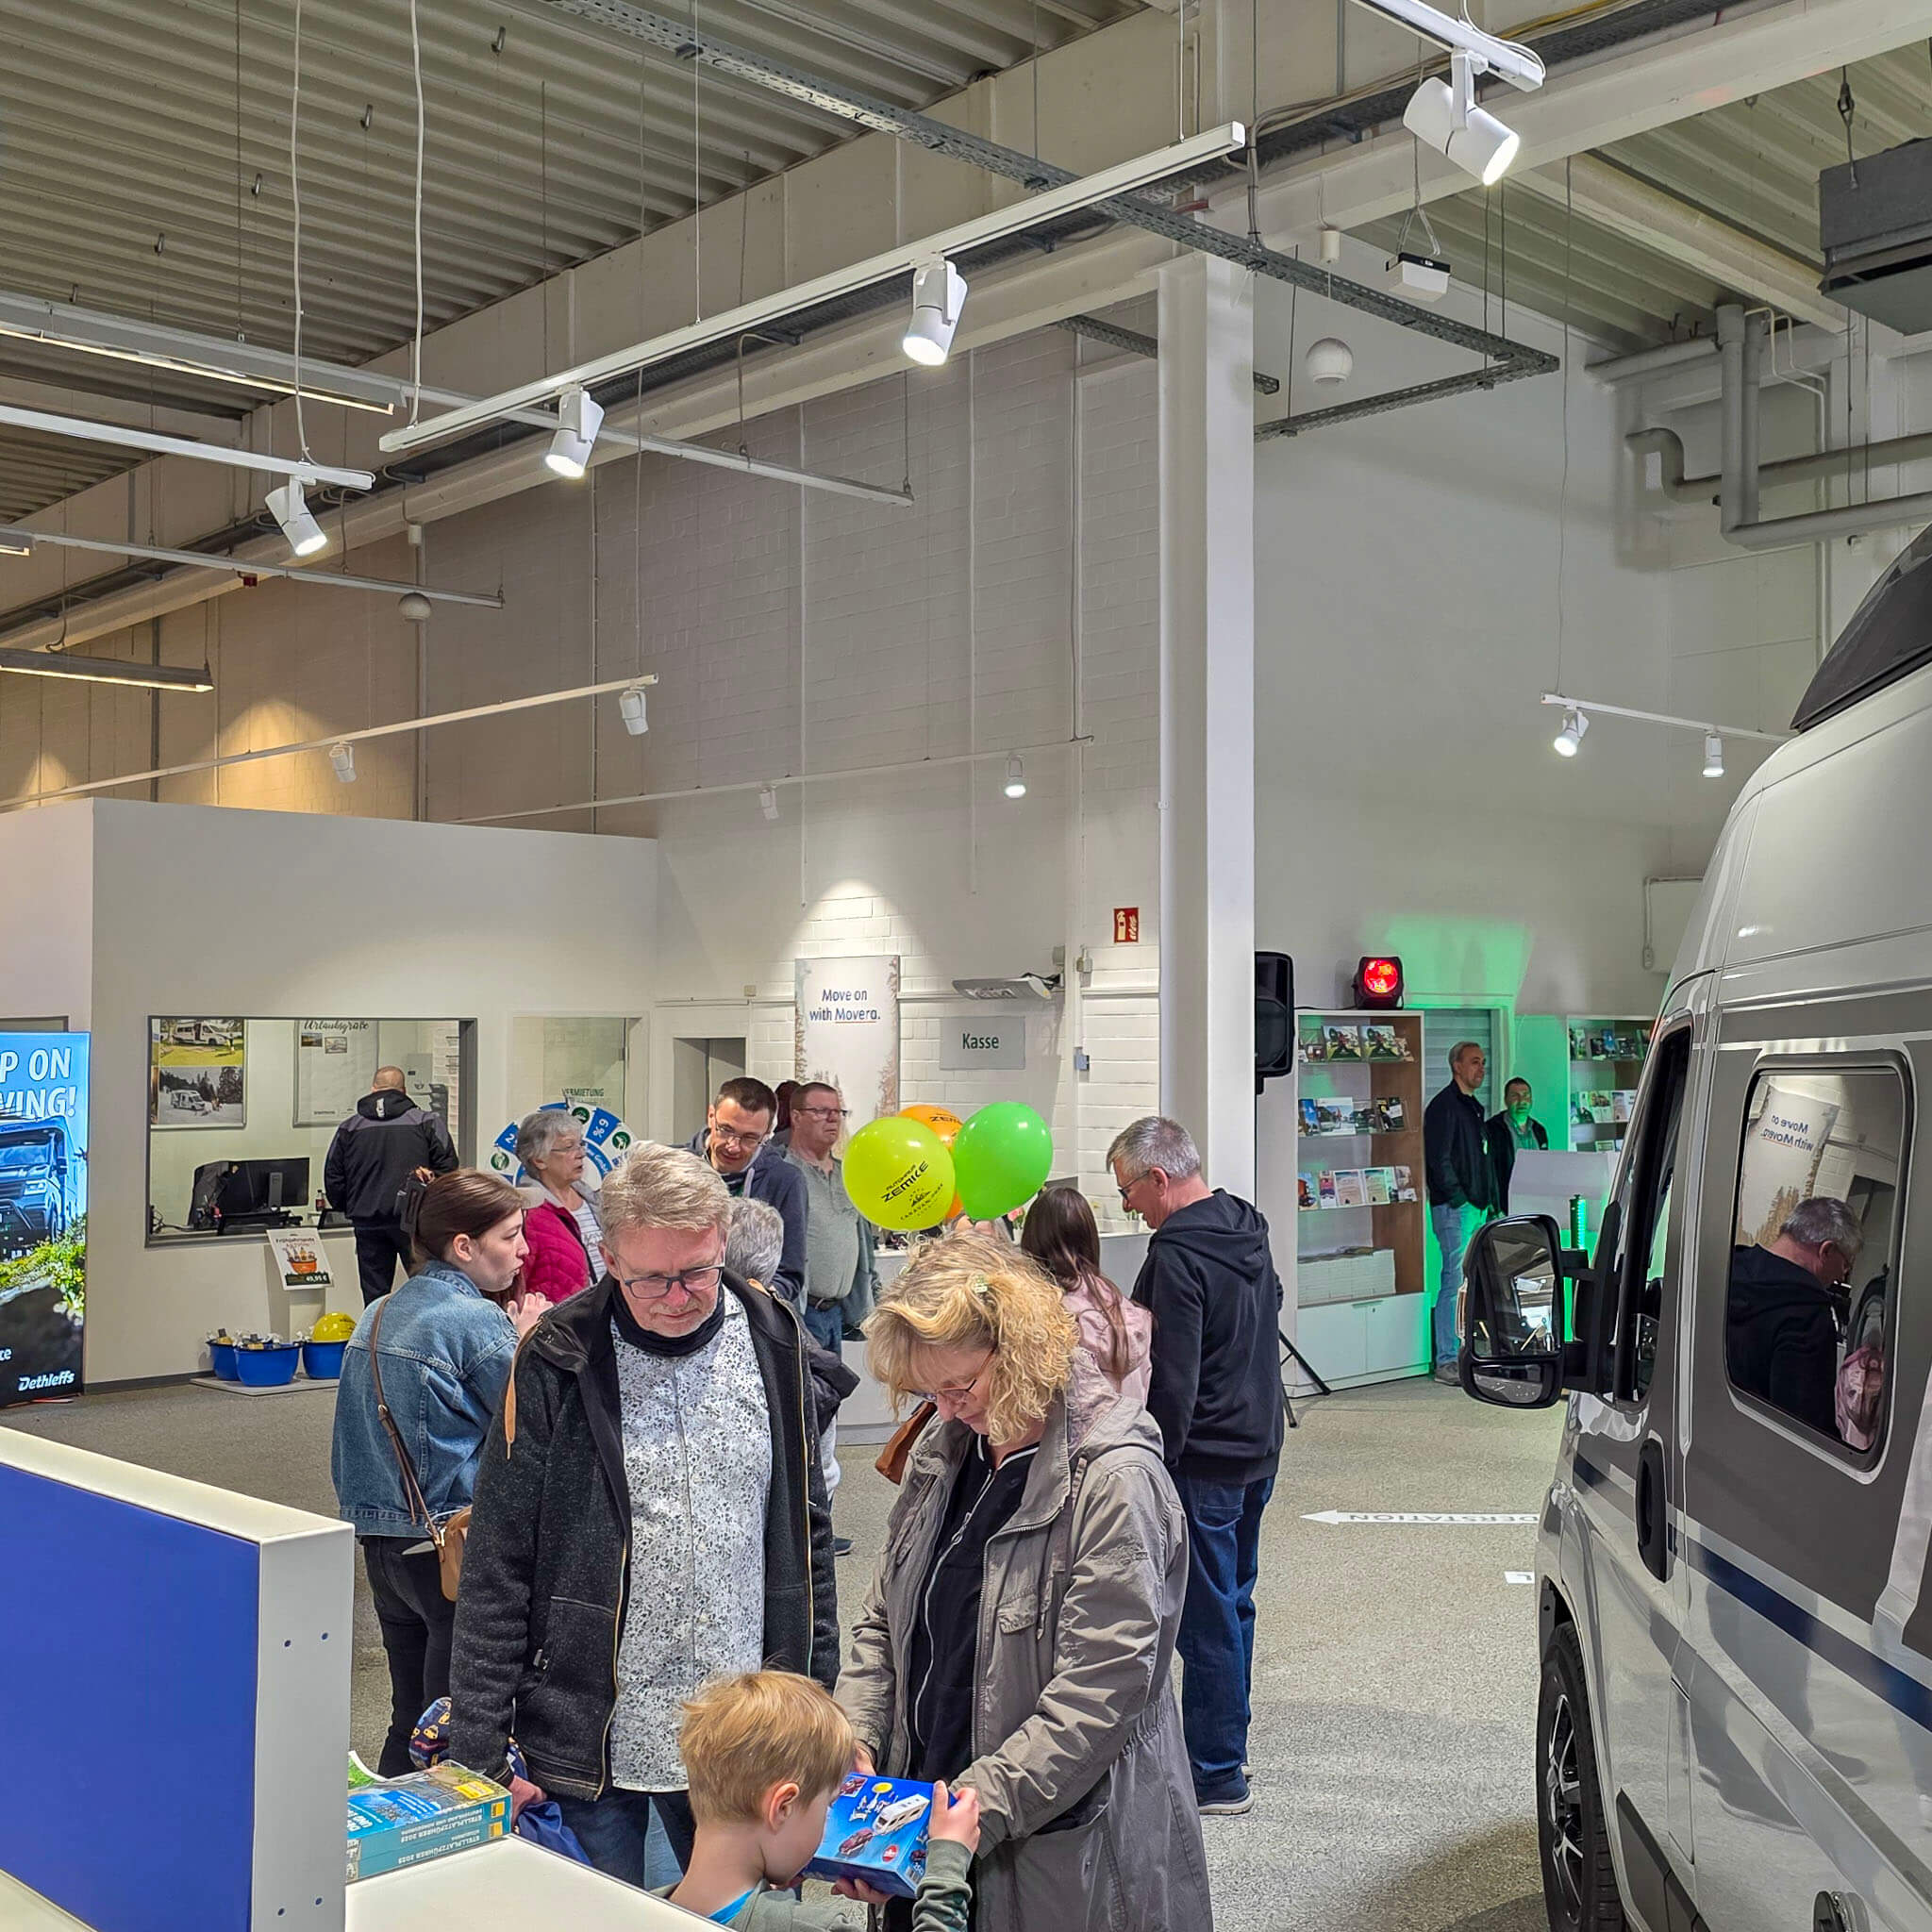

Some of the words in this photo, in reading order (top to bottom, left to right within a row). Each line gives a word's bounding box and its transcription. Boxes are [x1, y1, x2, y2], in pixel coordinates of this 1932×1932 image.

[822, 990, 851, 1002] Move
[854, 991, 867, 1001] on
[809, 1007, 832, 1021] with
[835, 1007, 881, 1021] Movera.
[962, 1033, 999, 1049] Kasse
[29, 1048, 72, 1081] ON
[18, 1370, 75, 1391] Dethleffs
